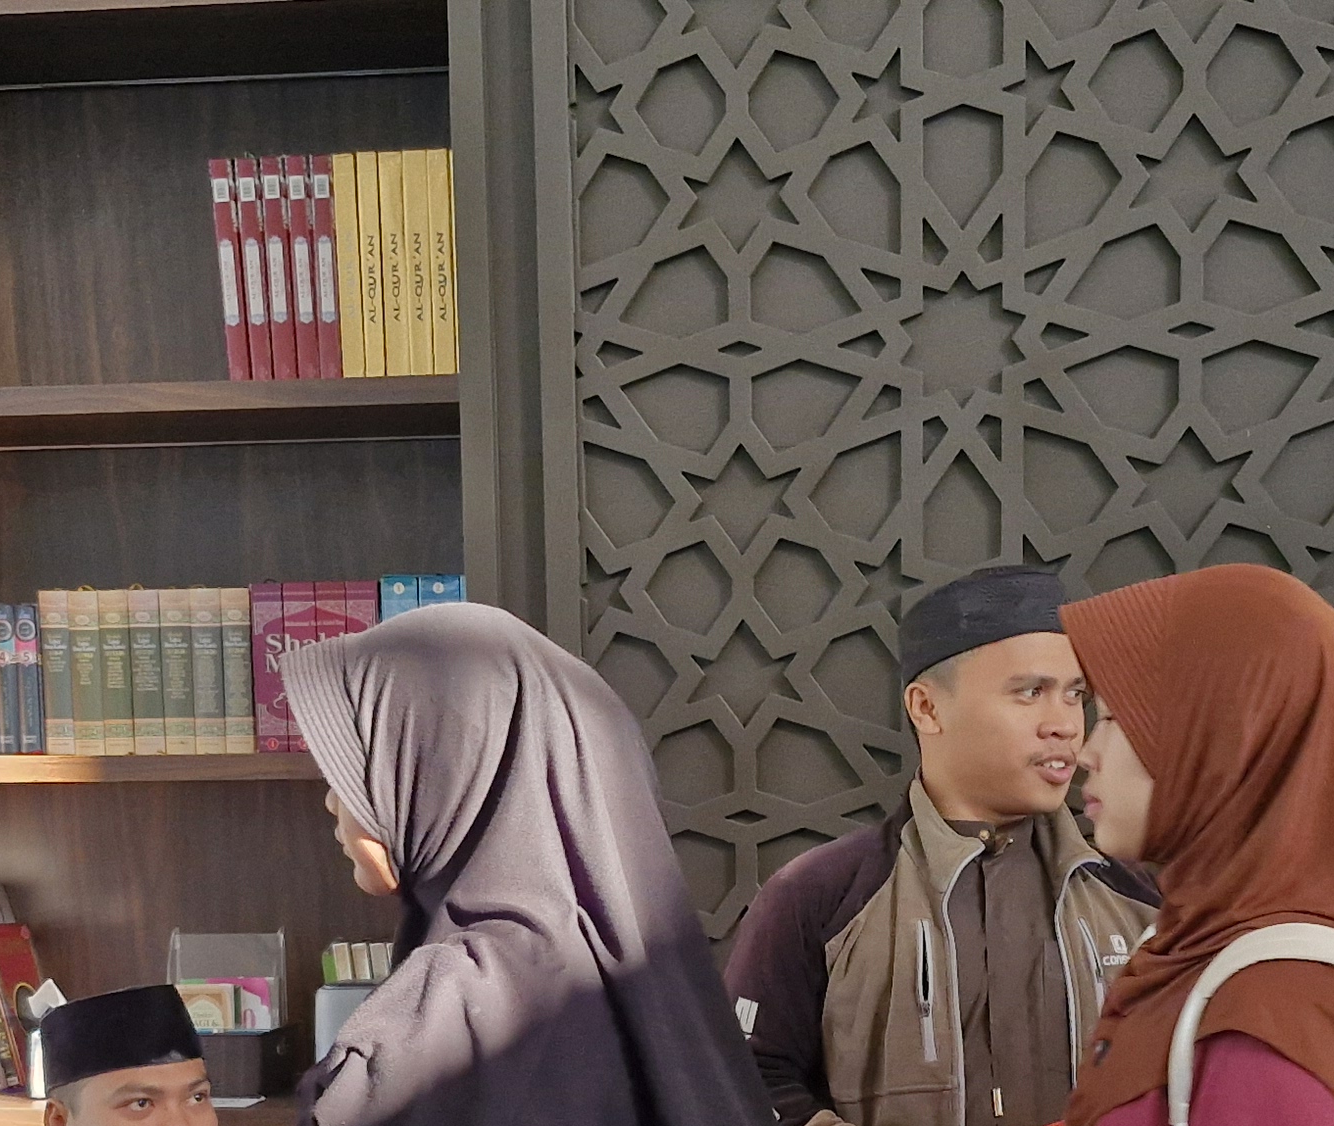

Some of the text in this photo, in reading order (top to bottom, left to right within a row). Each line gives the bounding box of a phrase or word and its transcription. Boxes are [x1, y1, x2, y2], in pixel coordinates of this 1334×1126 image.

[367, 234, 376, 323] AL-QUR'AN
[390, 233, 401, 322] AL-QUR'AN
[413, 232, 424, 321] AL-QUR'AN
[436, 231, 447, 321] AL-QUR'AN
